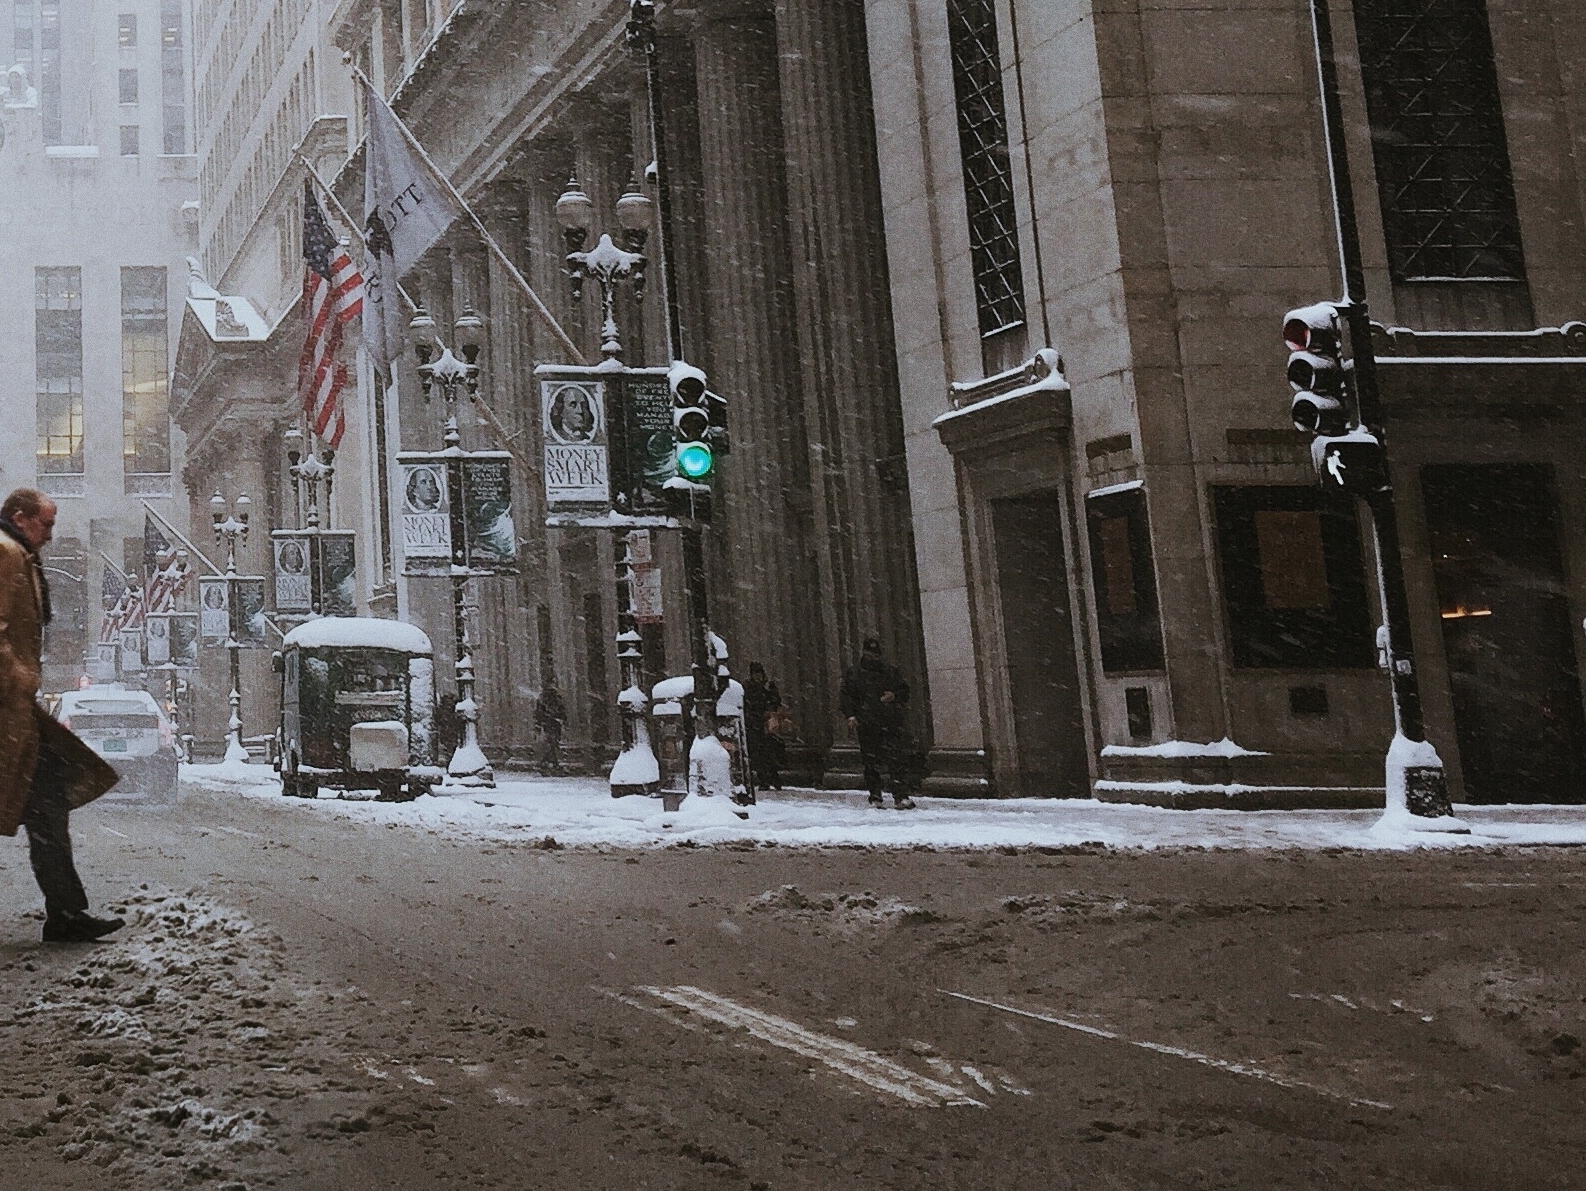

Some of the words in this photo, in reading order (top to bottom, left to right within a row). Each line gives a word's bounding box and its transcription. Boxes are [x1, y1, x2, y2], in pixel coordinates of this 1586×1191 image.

[547, 448, 603, 460] MONEY
[547, 460, 602, 472] SMART
[548, 471, 603, 485] WEEK
[405, 534, 448, 544] WEEK
